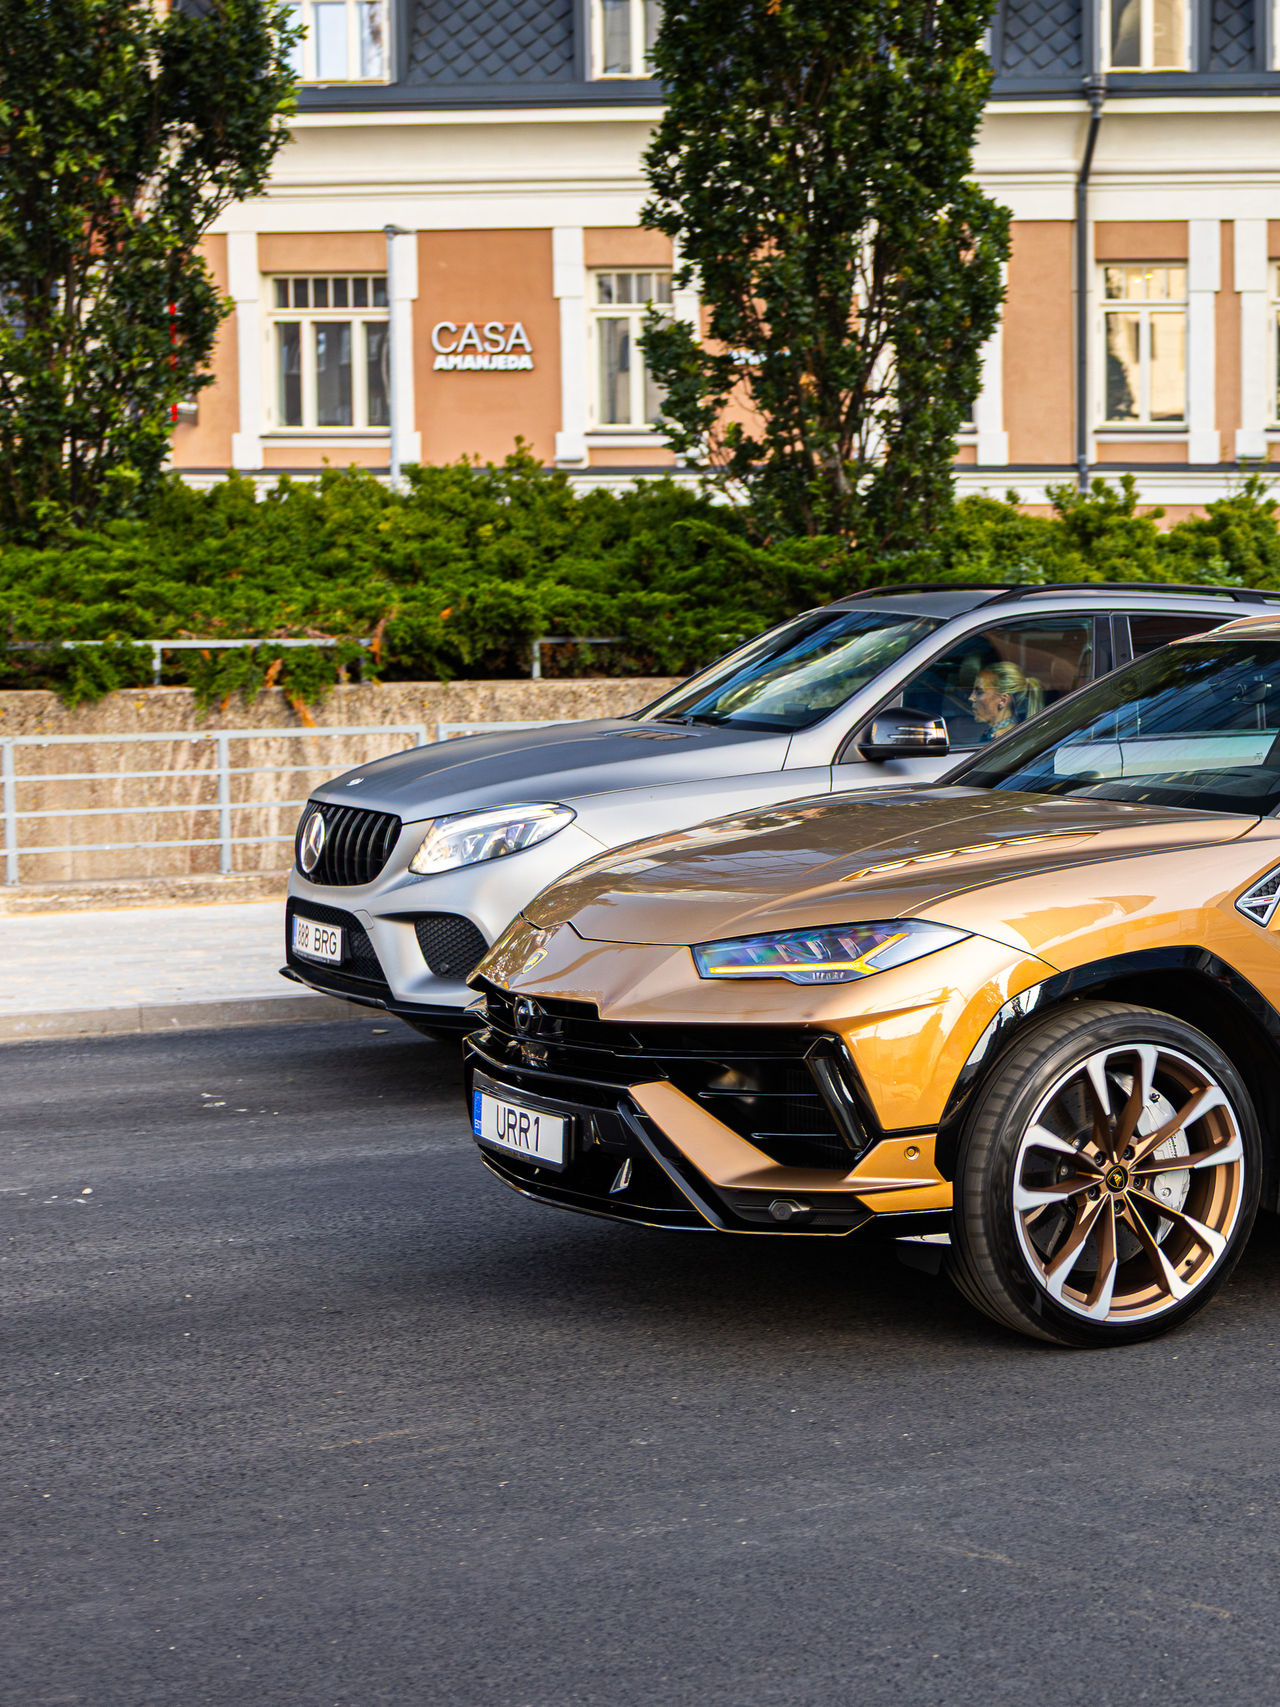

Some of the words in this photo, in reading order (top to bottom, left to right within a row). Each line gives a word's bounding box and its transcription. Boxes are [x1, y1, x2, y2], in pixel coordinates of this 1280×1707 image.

[431, 321, 533, 354] CASA
[433, 354, 534, 370] AMANJEDA
[314, 926, 338, 956] BRG
[496, 1104, 541, 1153] URR1
